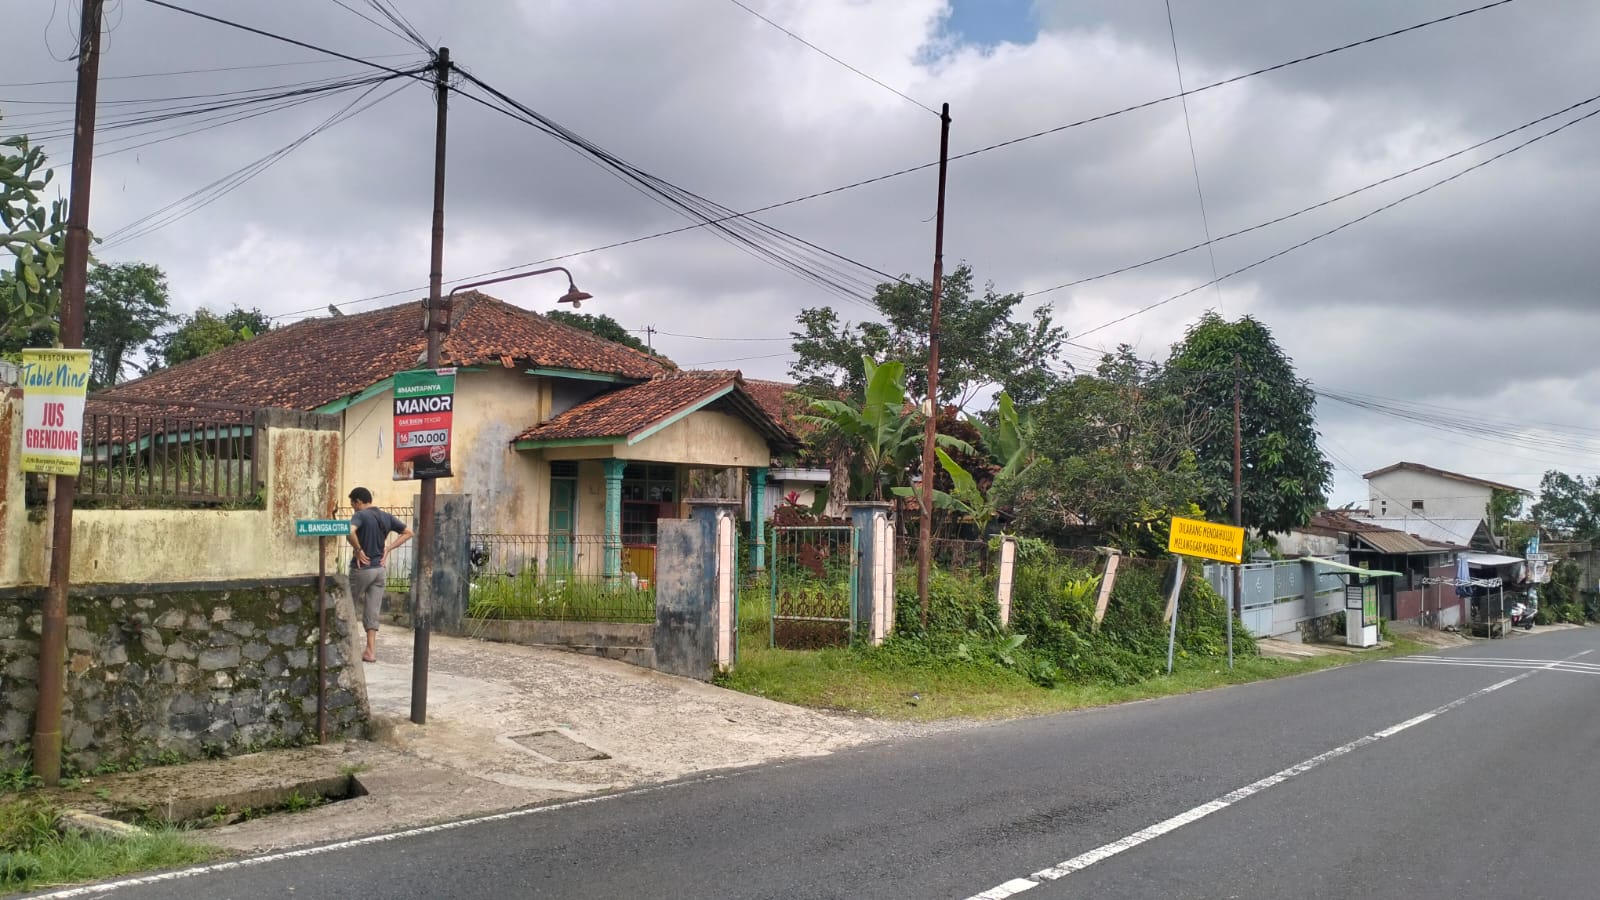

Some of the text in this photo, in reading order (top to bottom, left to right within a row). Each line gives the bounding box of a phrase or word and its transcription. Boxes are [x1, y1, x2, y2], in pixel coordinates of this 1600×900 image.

[38, 354, 75, 362] RESTORAN
[24, 363, 86, 388] Table Nine
[397, 384, 441, 393] #MANTAPNYA
[396, 396, 451, 415] MANOR
[42, 402, 64, 427] JUS
[26, 429, 78, 451] GRENDONG
[414, 433, 446, 444] 10.000
[299, 523, 307, 532] JL.
[1179, 523, 1201, 536] DILARANG
[1174, 538, 1238, 558] MELANGGAR MARKA TENGAH
